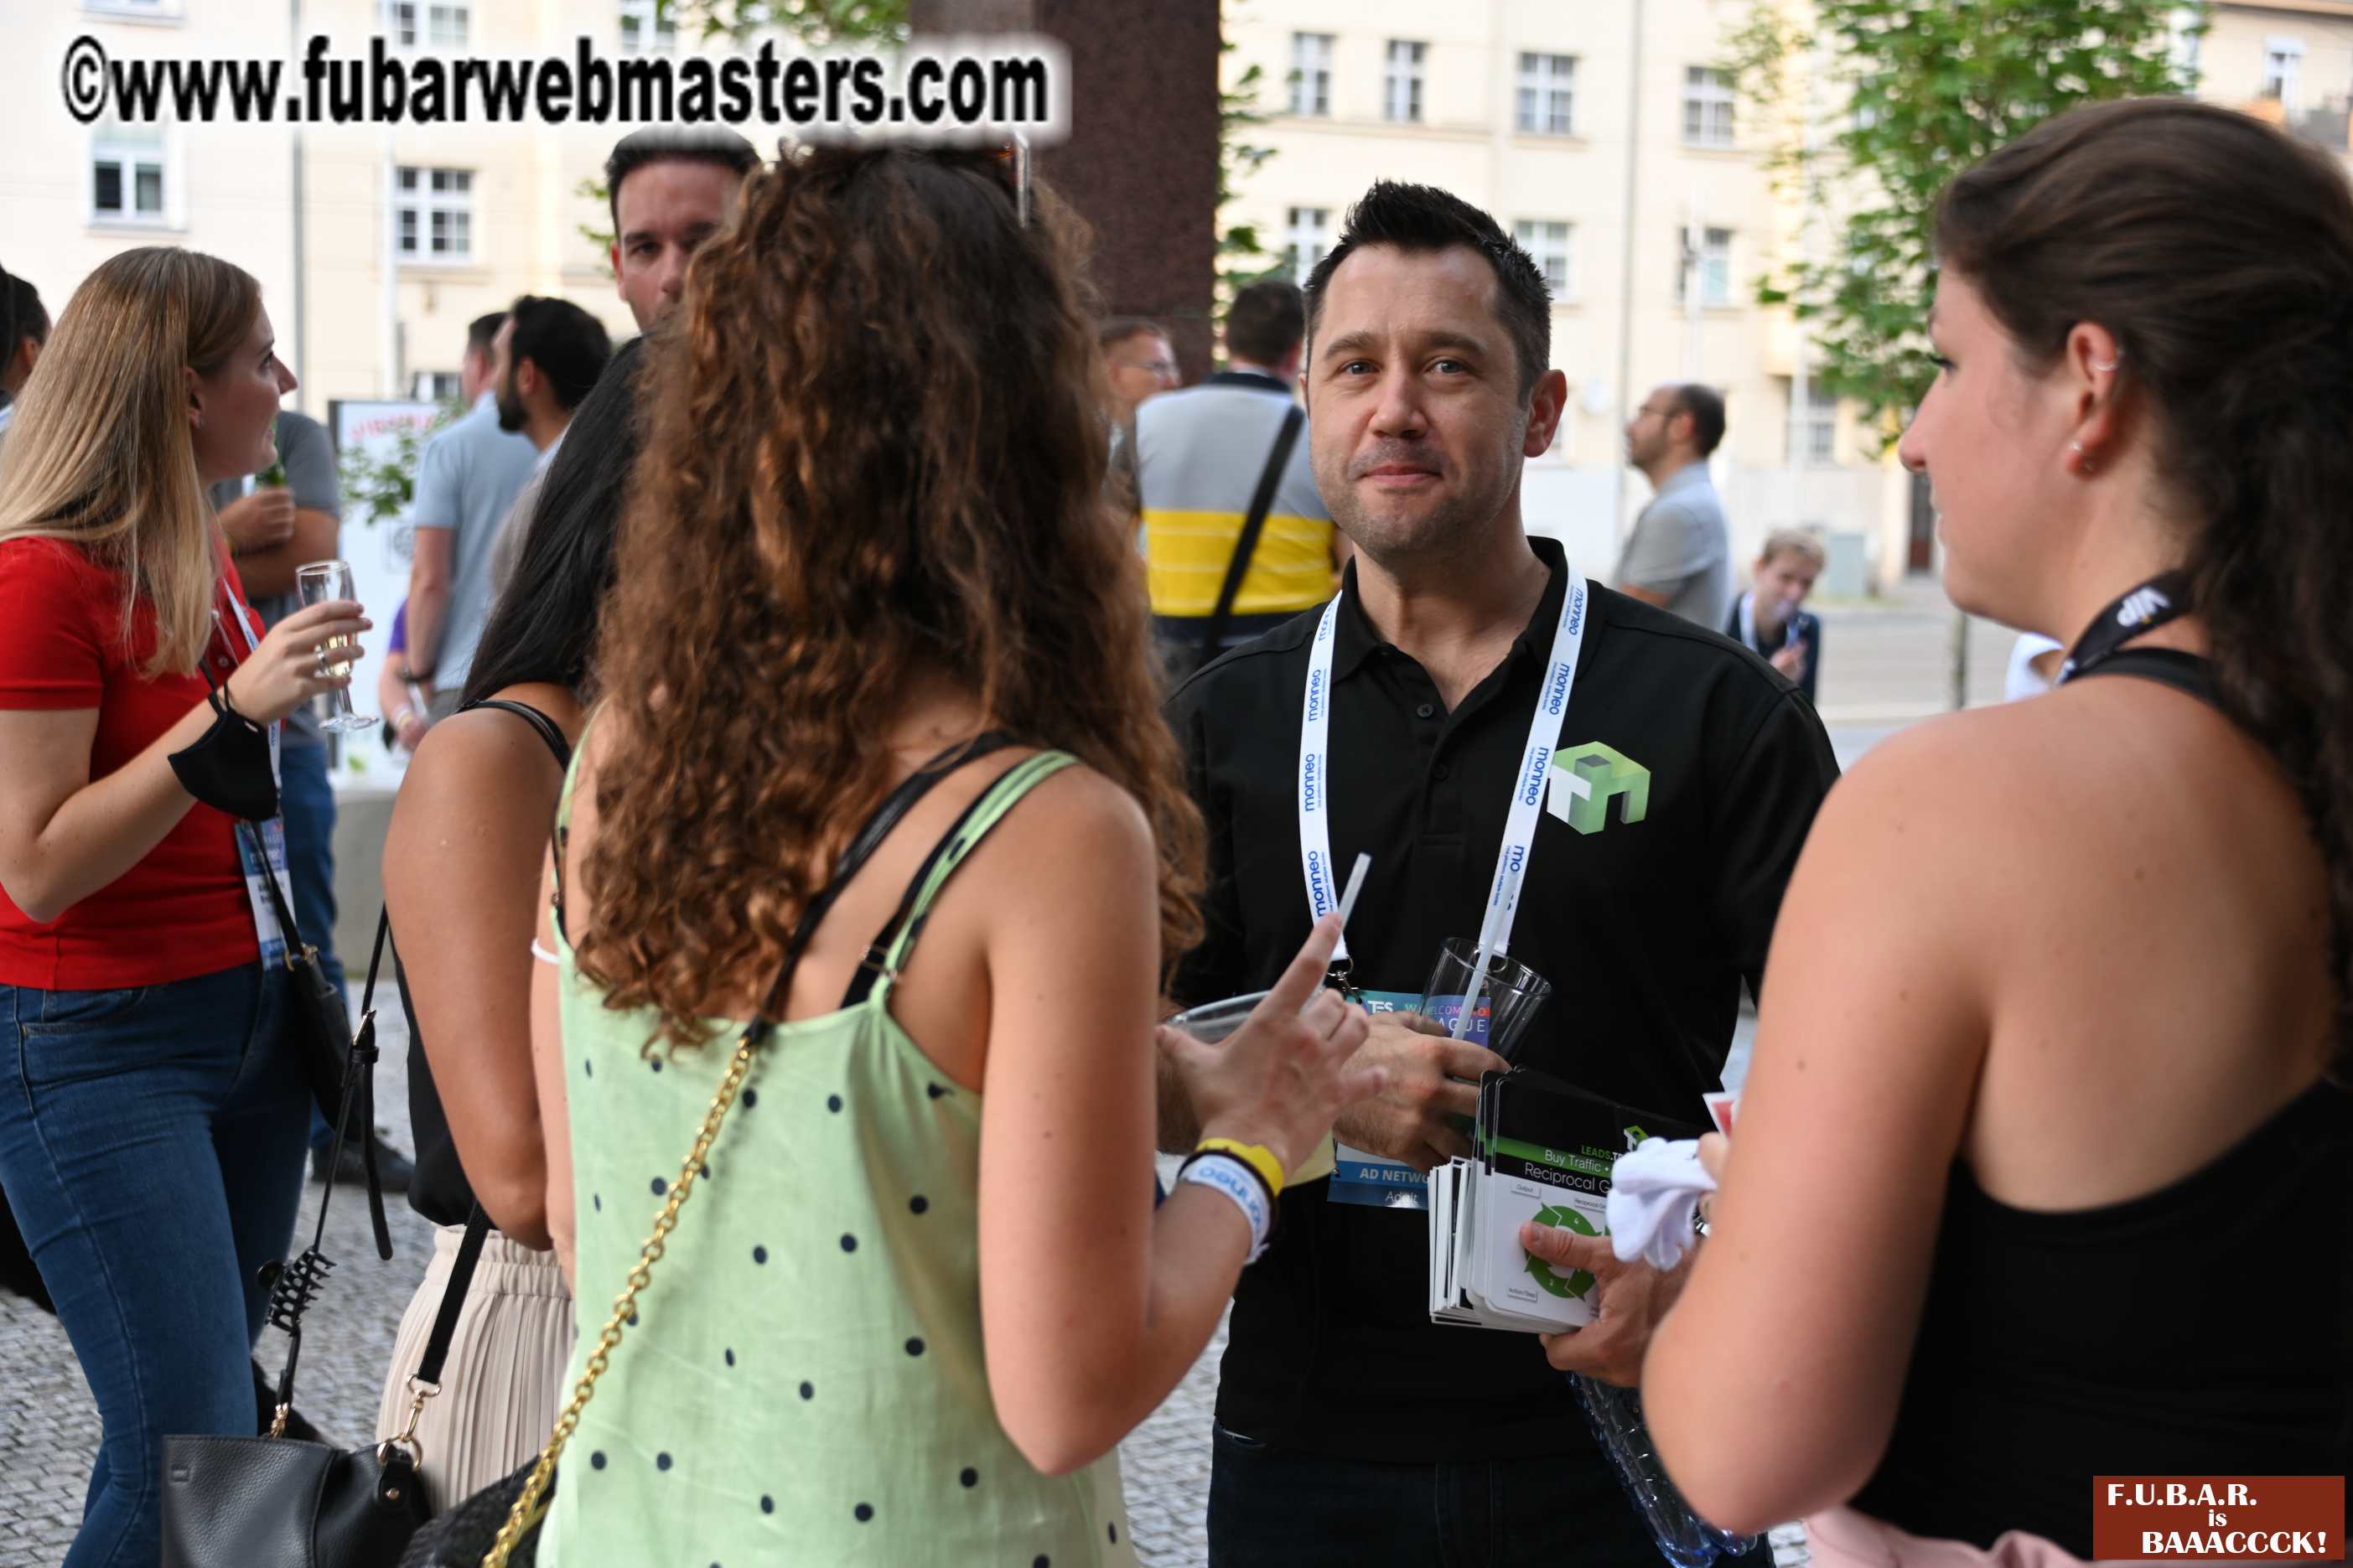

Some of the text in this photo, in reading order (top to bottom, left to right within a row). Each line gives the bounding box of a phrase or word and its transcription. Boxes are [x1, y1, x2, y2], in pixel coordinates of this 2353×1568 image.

[1568, 587, 1583, 635] monneo
[1309, 670, 1321, 722] monneo
[1549, 663, 1570, 715] monneo
[1305, 753, 1315, 811] monneo
[1526, 747, 1549, 805] monneo
[1309, 851, 1326, 917] monneo
[1367, 1001, 1393, 1013] TES
[1359, 1167, 1379, 1179] AD
[1525, 1162, 1595, 1190] Reciprocal
[1545, 1149, 1601, 1172] Buy Traffic
